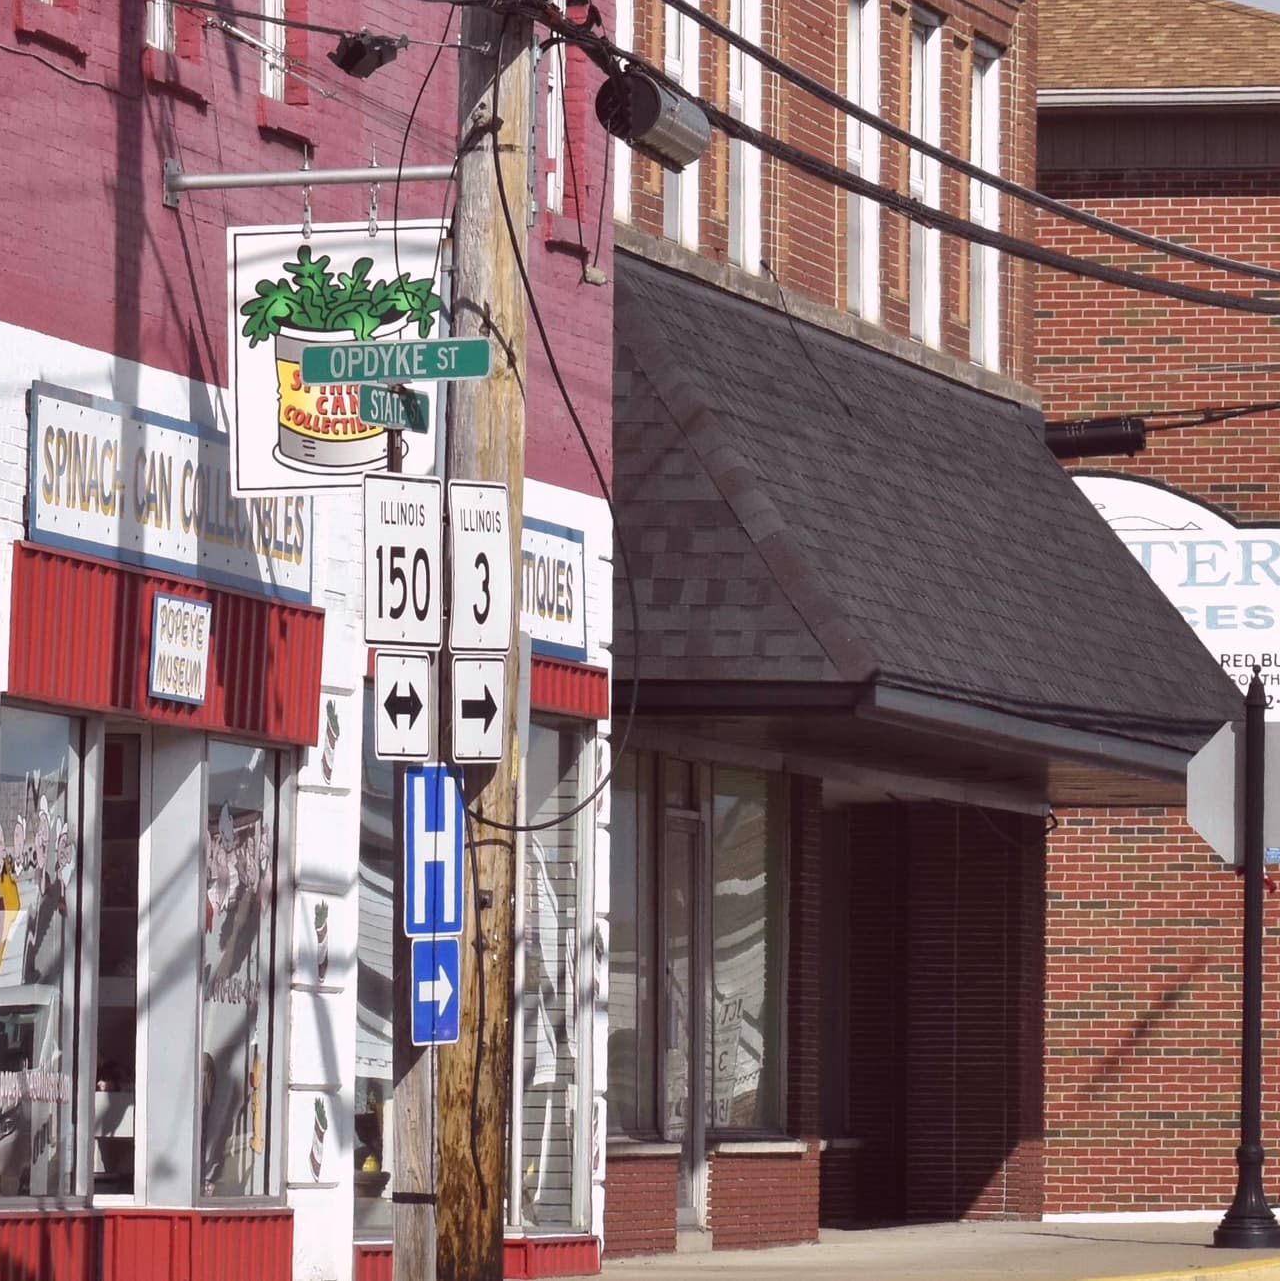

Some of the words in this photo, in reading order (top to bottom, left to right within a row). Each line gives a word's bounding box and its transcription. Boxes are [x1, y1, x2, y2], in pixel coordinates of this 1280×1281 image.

[330, 343, 427, 378] OPDYKE
[437, 347, 460, 371] ST
[283, 403, 377, 436] COLLECTIB
[370, 388, 406, 425] STATE
[41, 424, 125, 519] SPINACH
[133, 446, 173, 533] CAN
[380, 500, 426, 527] ILLINOIS
[460, 508, 502, 534] ILLINOIS
[376, 545, 431, 622] 150
[472, 551, 491, 625] 3
[521, 548, 574, 624] TIQUES
[159, 603, 205, 651] POPEYE
[155, 651, 202, 695] MUSEUM
[1220, 653, 1256, 669] RED
[1227, 673, 1280, 687] OTH
[413, 776, 457, 925] H
